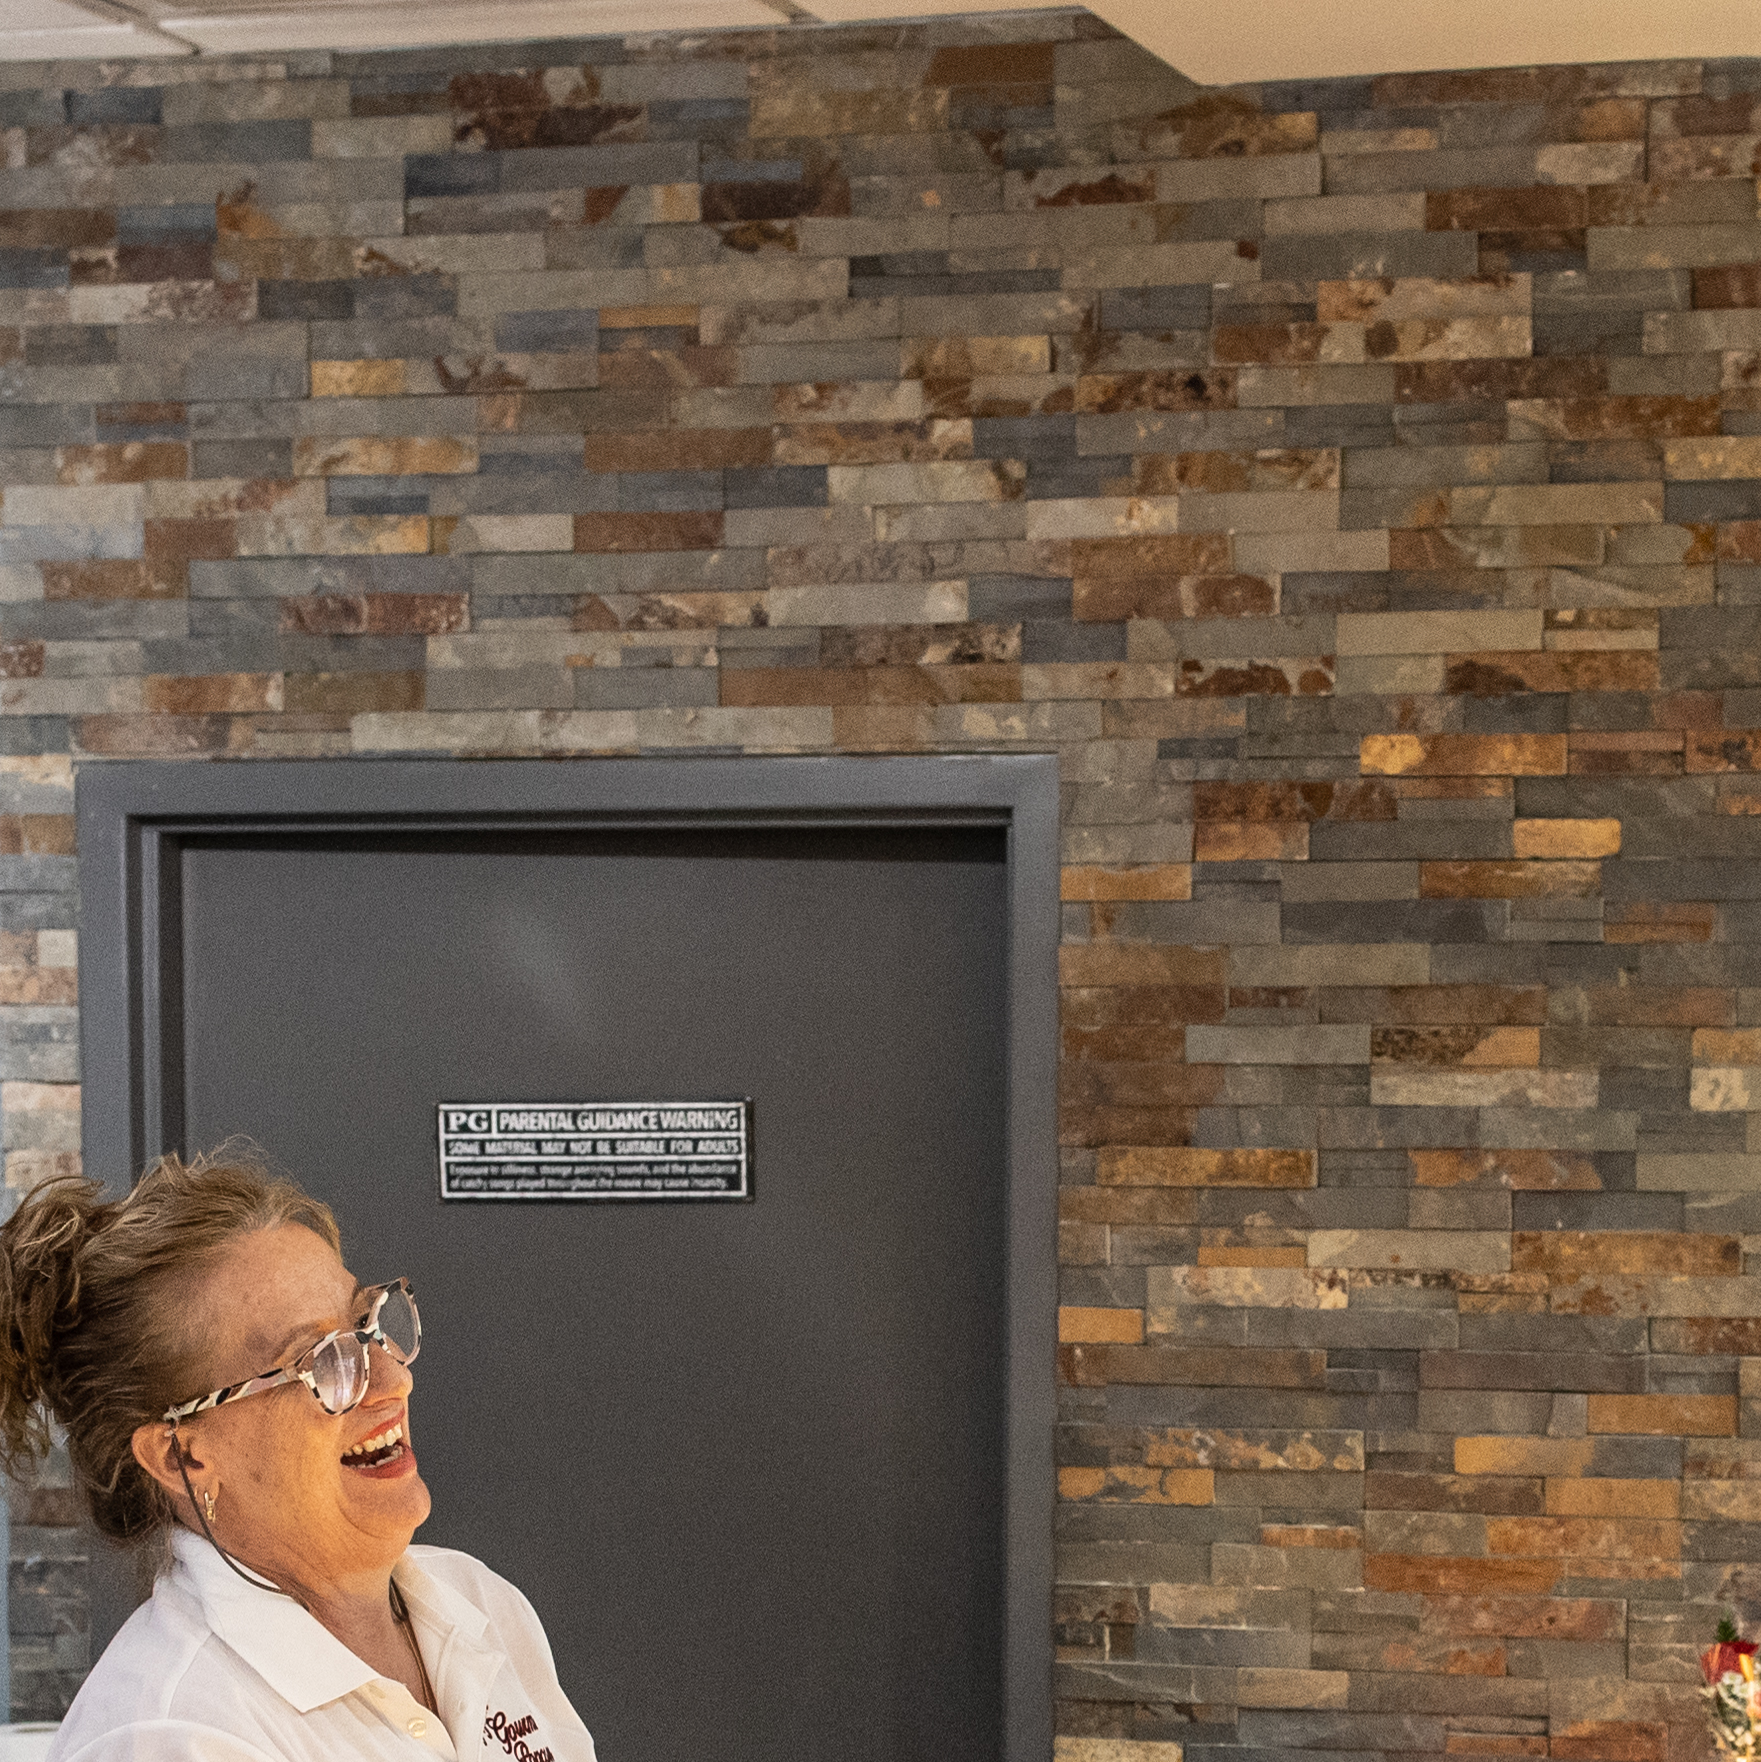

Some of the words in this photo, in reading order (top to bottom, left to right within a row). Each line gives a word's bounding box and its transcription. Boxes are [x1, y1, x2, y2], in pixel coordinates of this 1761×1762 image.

[447, 1111, 489, 1132] PG
[499, 1111, 576, 1131] PARENTAL
[578, 1110, 658, 1131] GUIDANCE
[659, 1110, 738, 1130] WARNING
[569, 1140, 592, 1154] NOT
[670, 1140, 693, 1154] FOR
[697, 1140, 738, 1154] ADULTS
